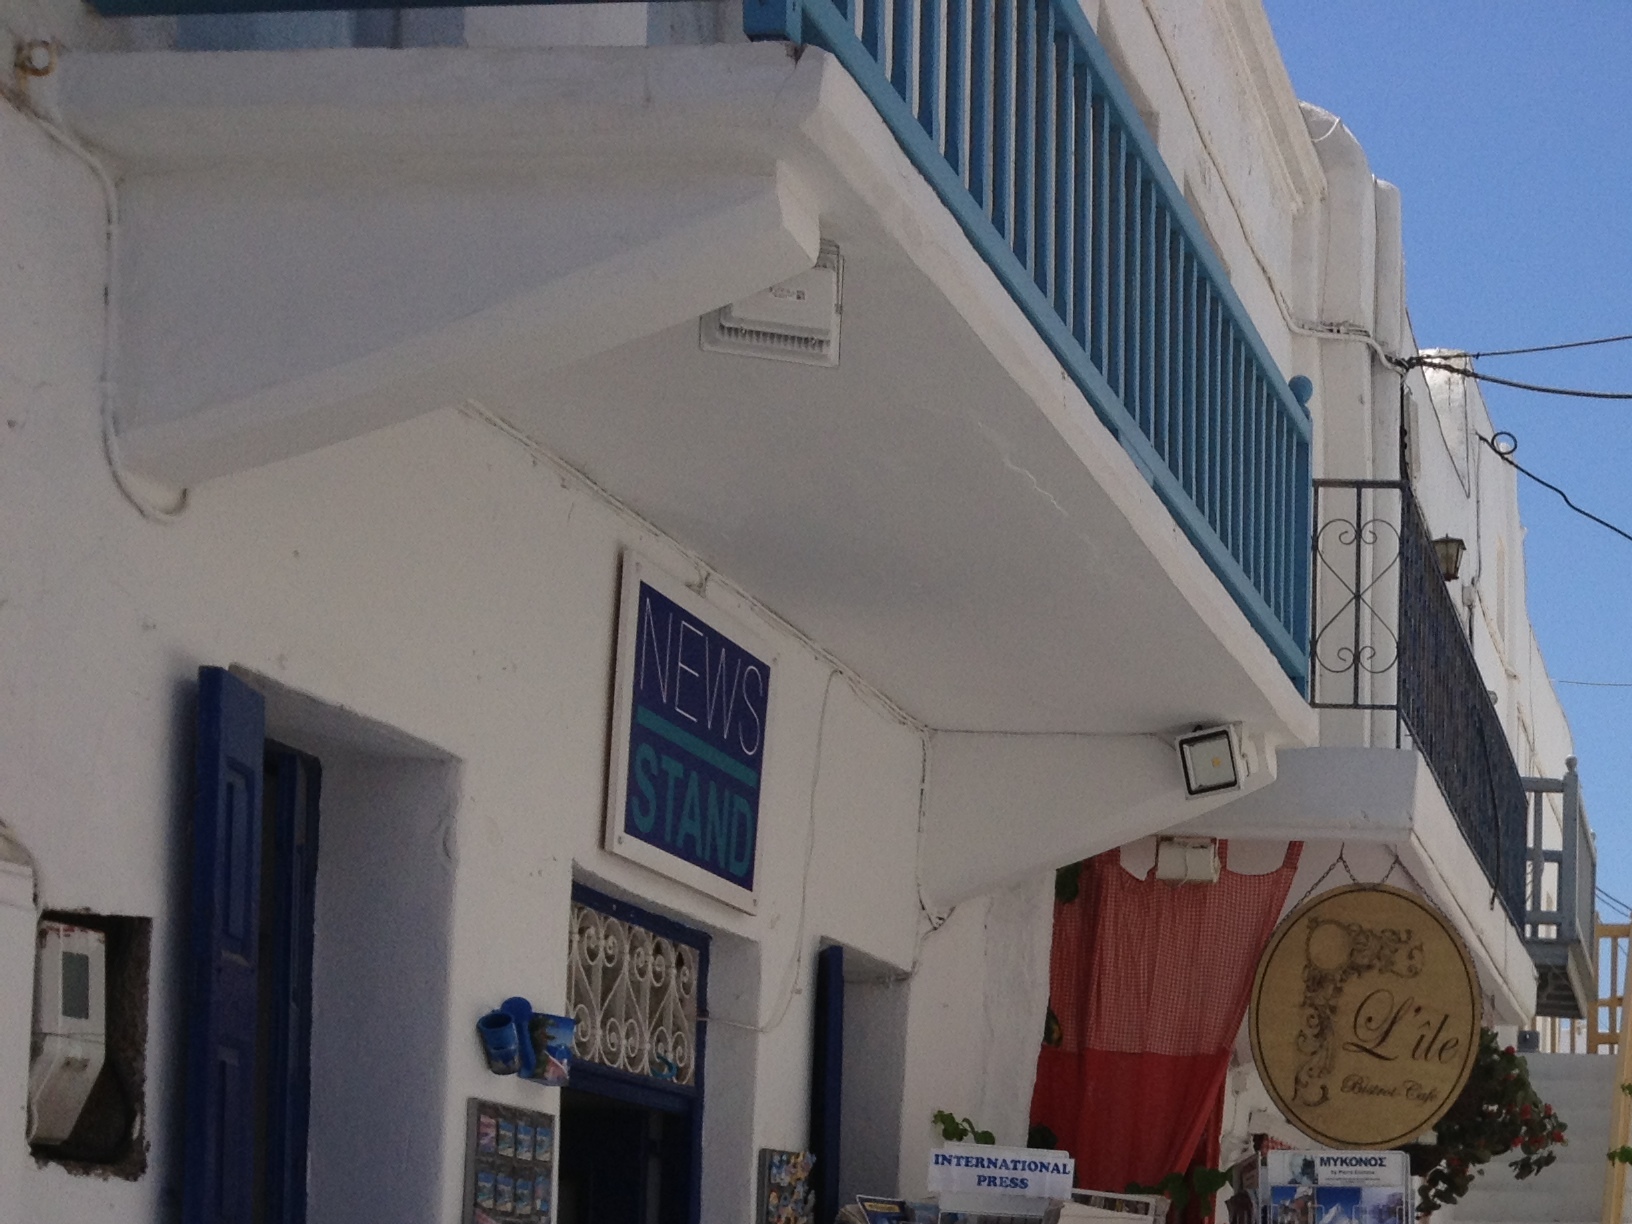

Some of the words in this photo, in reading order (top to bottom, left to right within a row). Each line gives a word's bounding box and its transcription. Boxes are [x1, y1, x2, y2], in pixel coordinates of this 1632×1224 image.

[640, 597, 764, 756] NEWS
[631, 742, 755, 878] STAND
[934, 1153, 1071, 1175] INTERNATIONAL
[976, 1174, 1029, 1190] PRESS
